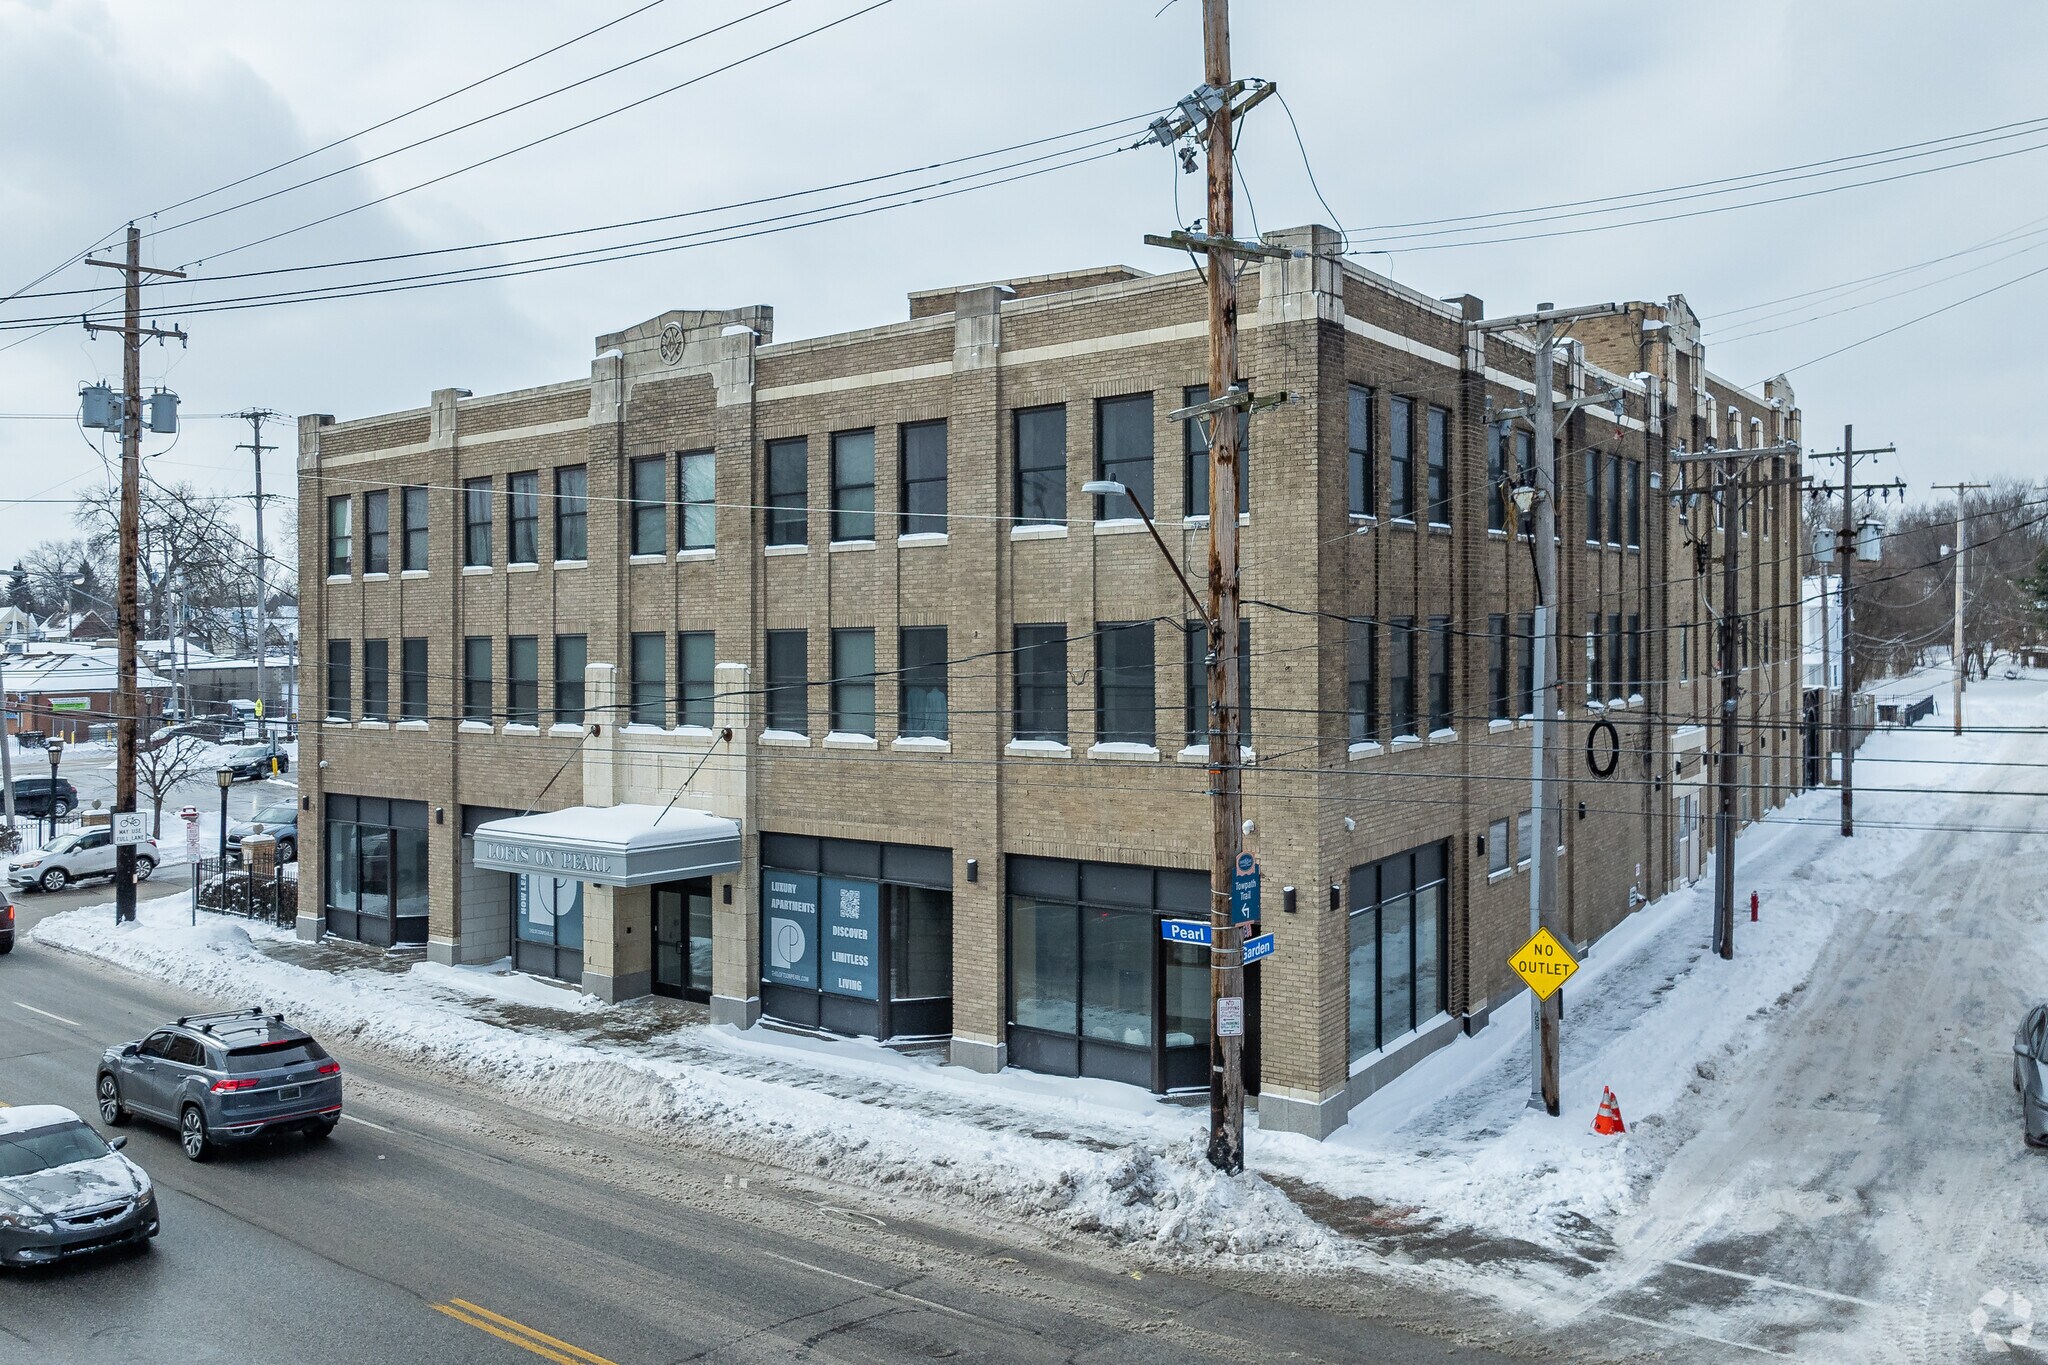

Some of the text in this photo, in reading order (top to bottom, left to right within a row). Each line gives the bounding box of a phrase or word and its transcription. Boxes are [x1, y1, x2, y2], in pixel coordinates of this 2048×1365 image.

[487, 843, 611, 873] LOFTS ON PEARL
[771, 881, 797, 894] LUXURY
[1235, 879, 1257, 891] Towpath
[1240, 891, 1251, 901] Trail
[771, 898, 815, 914] APARTMENTS
[832, 925, 868, 940] DISCOVER
[1171, 925, 1204, 941] Pearl
[1243, 941, 1270, 960] Garden
[1534, 943, 1553, 956] NO
[831, 951, 869, 967] LIMITLESS
[1519, 960, 1570, 976] OUTLET
[838, 977, 862, 992] LIVING
